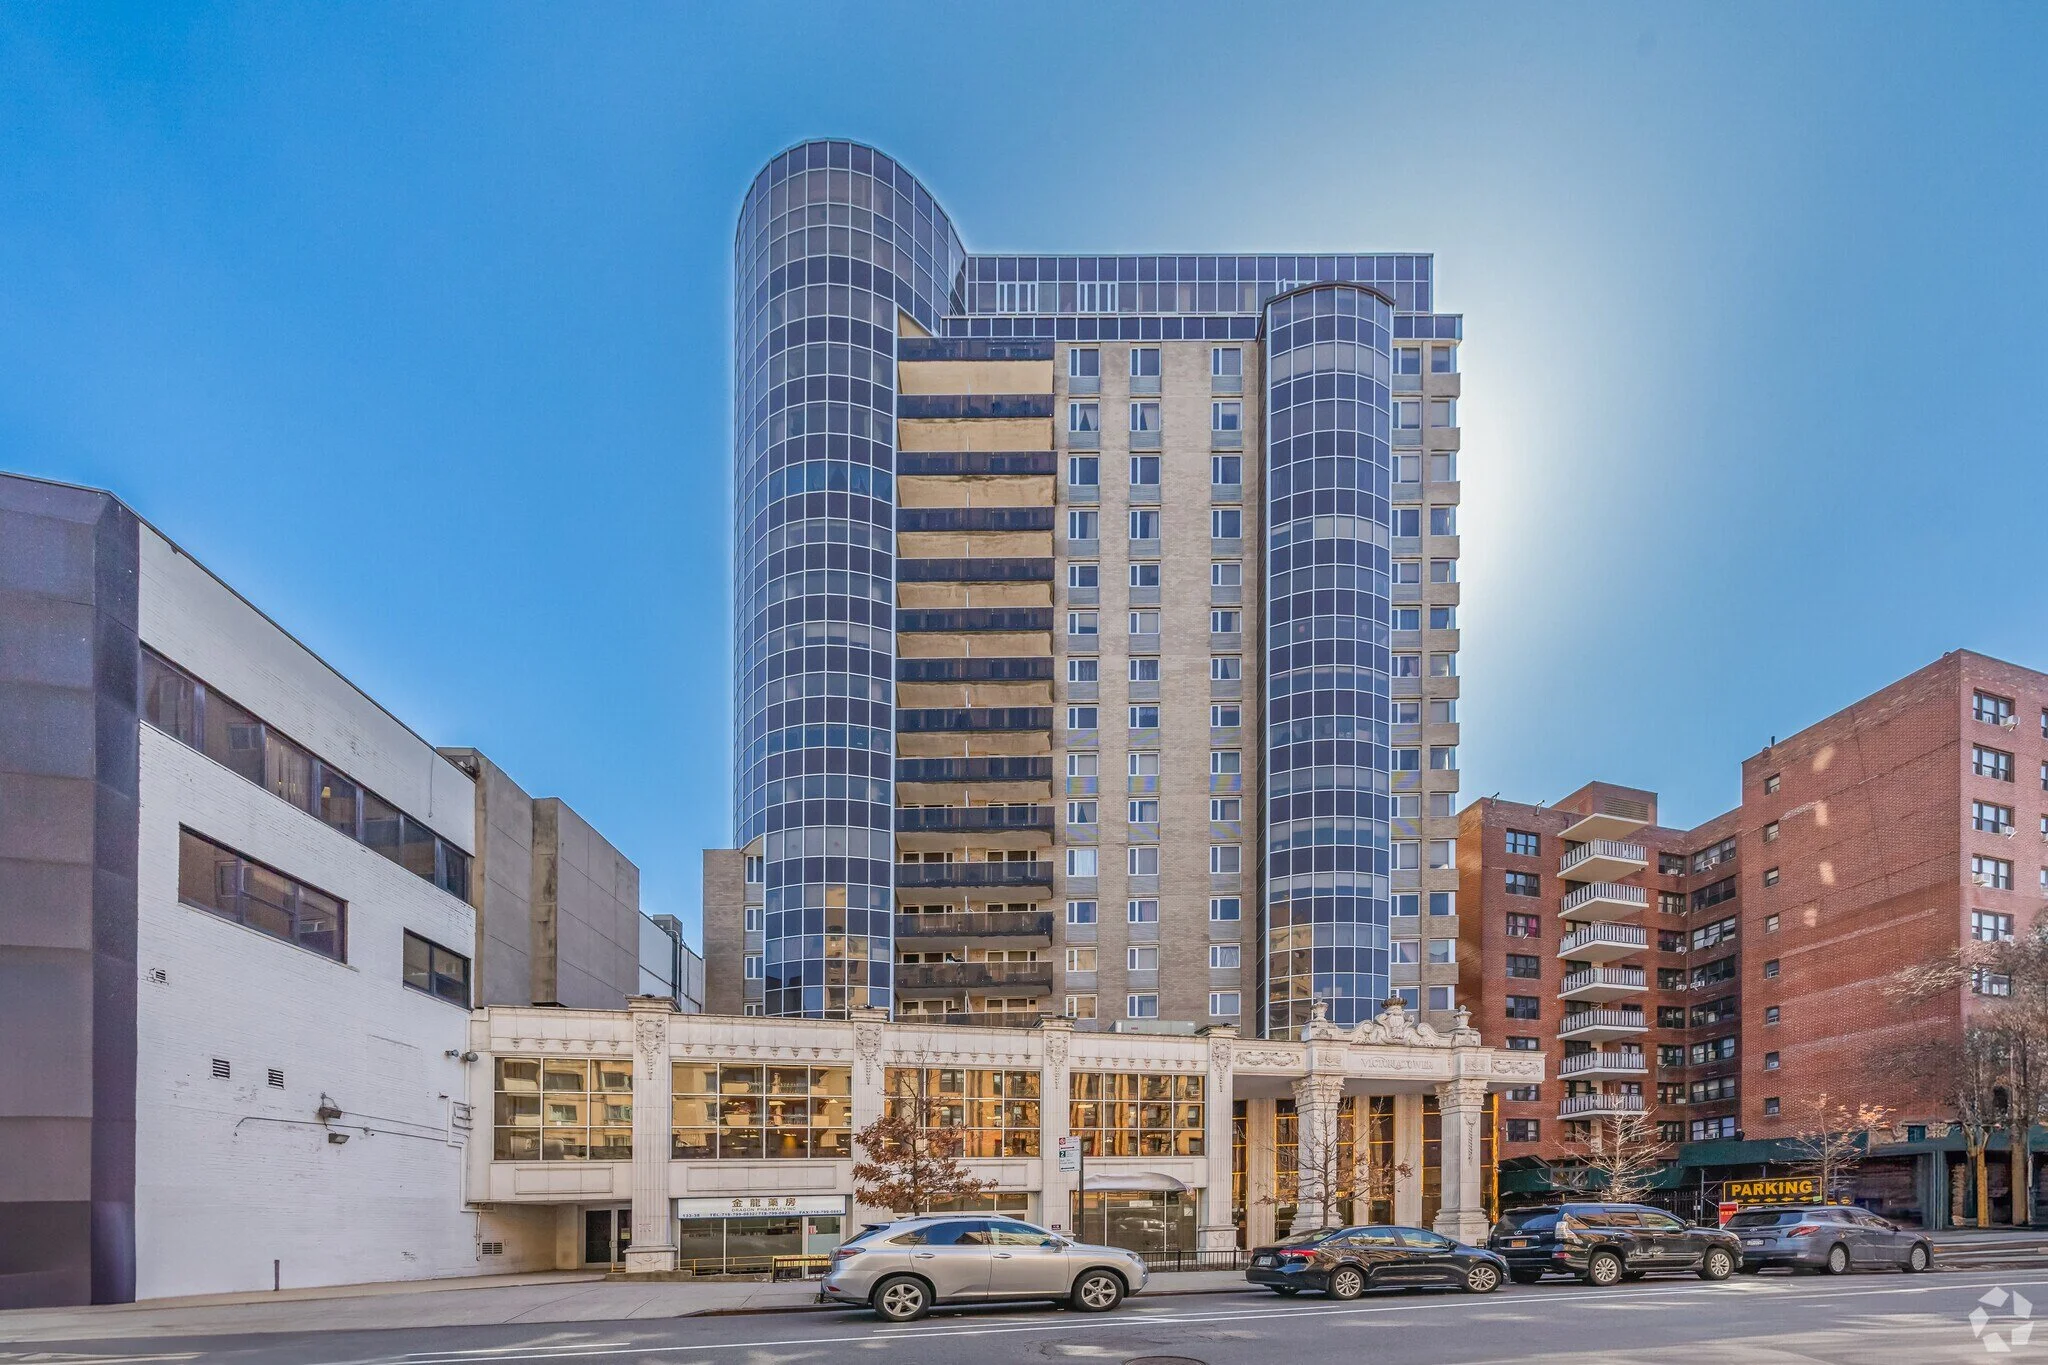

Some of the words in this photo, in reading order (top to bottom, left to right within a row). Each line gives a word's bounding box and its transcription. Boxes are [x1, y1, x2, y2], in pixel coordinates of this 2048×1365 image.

[1731, 1180, 1813, 1197] PARKING
[732, 1198, 796, 1208] 金龍藥房
